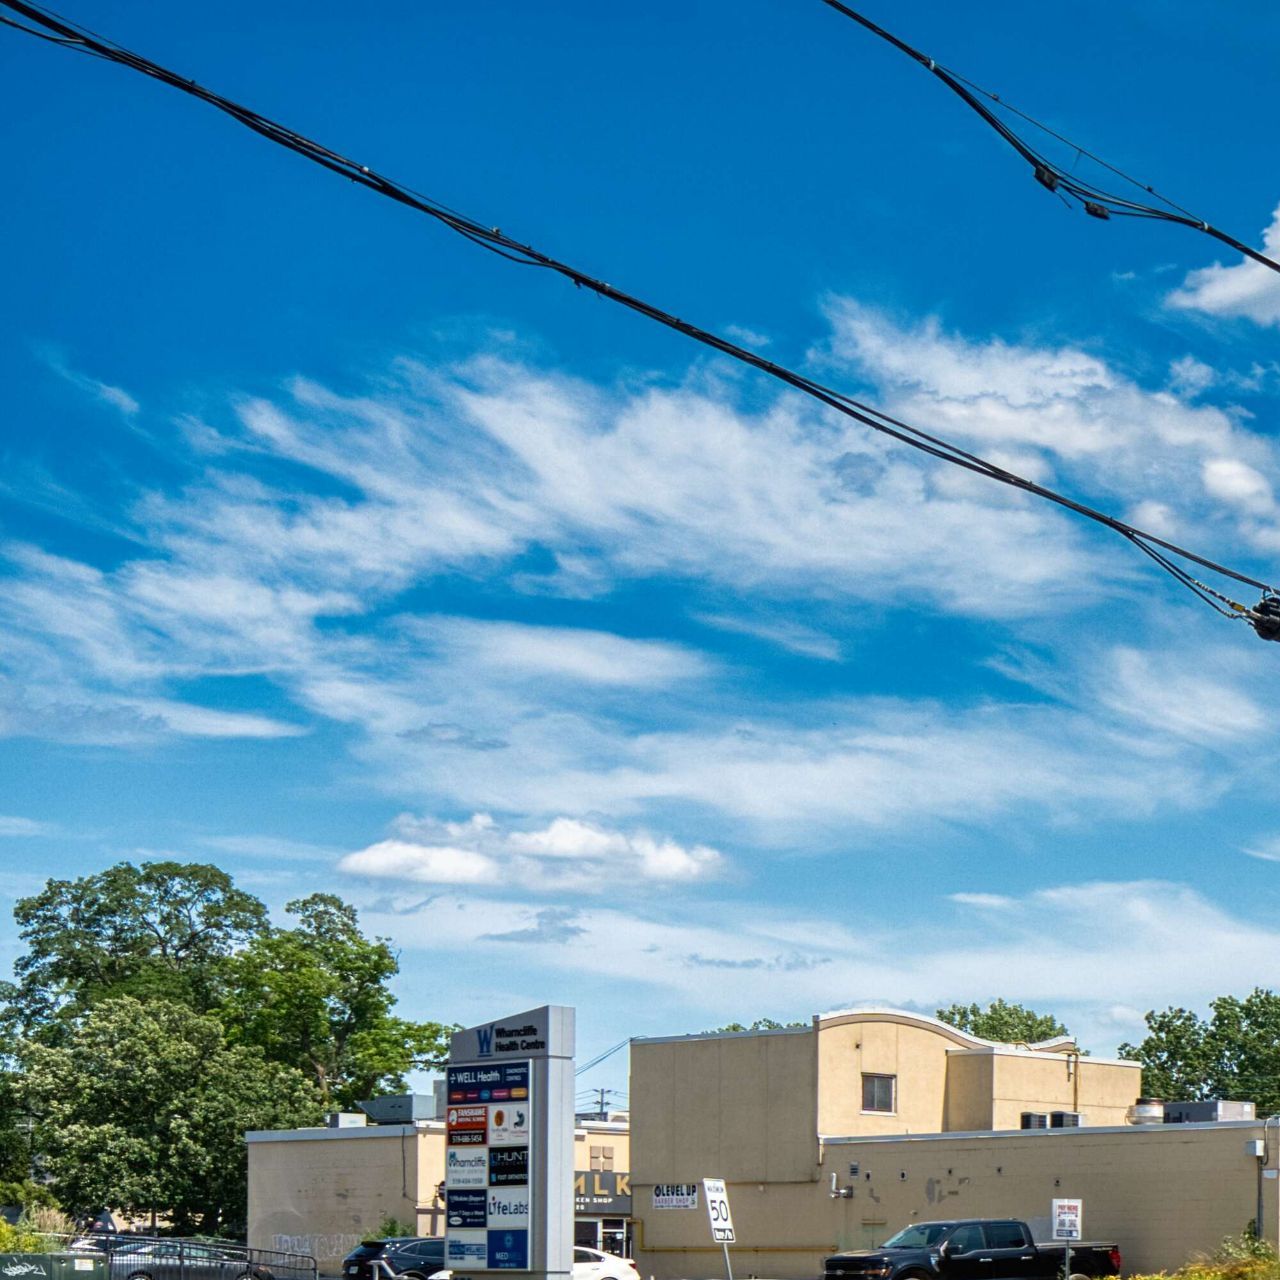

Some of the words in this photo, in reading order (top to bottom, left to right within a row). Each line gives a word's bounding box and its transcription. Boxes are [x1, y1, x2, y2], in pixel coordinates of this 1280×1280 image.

[521, 1039, 545, 1050] Centre
[661, 1184, 685, 1196] LEVEL
[686, 1184, 697, 1196] UP
[710, 1199, 729, 1222] 50
